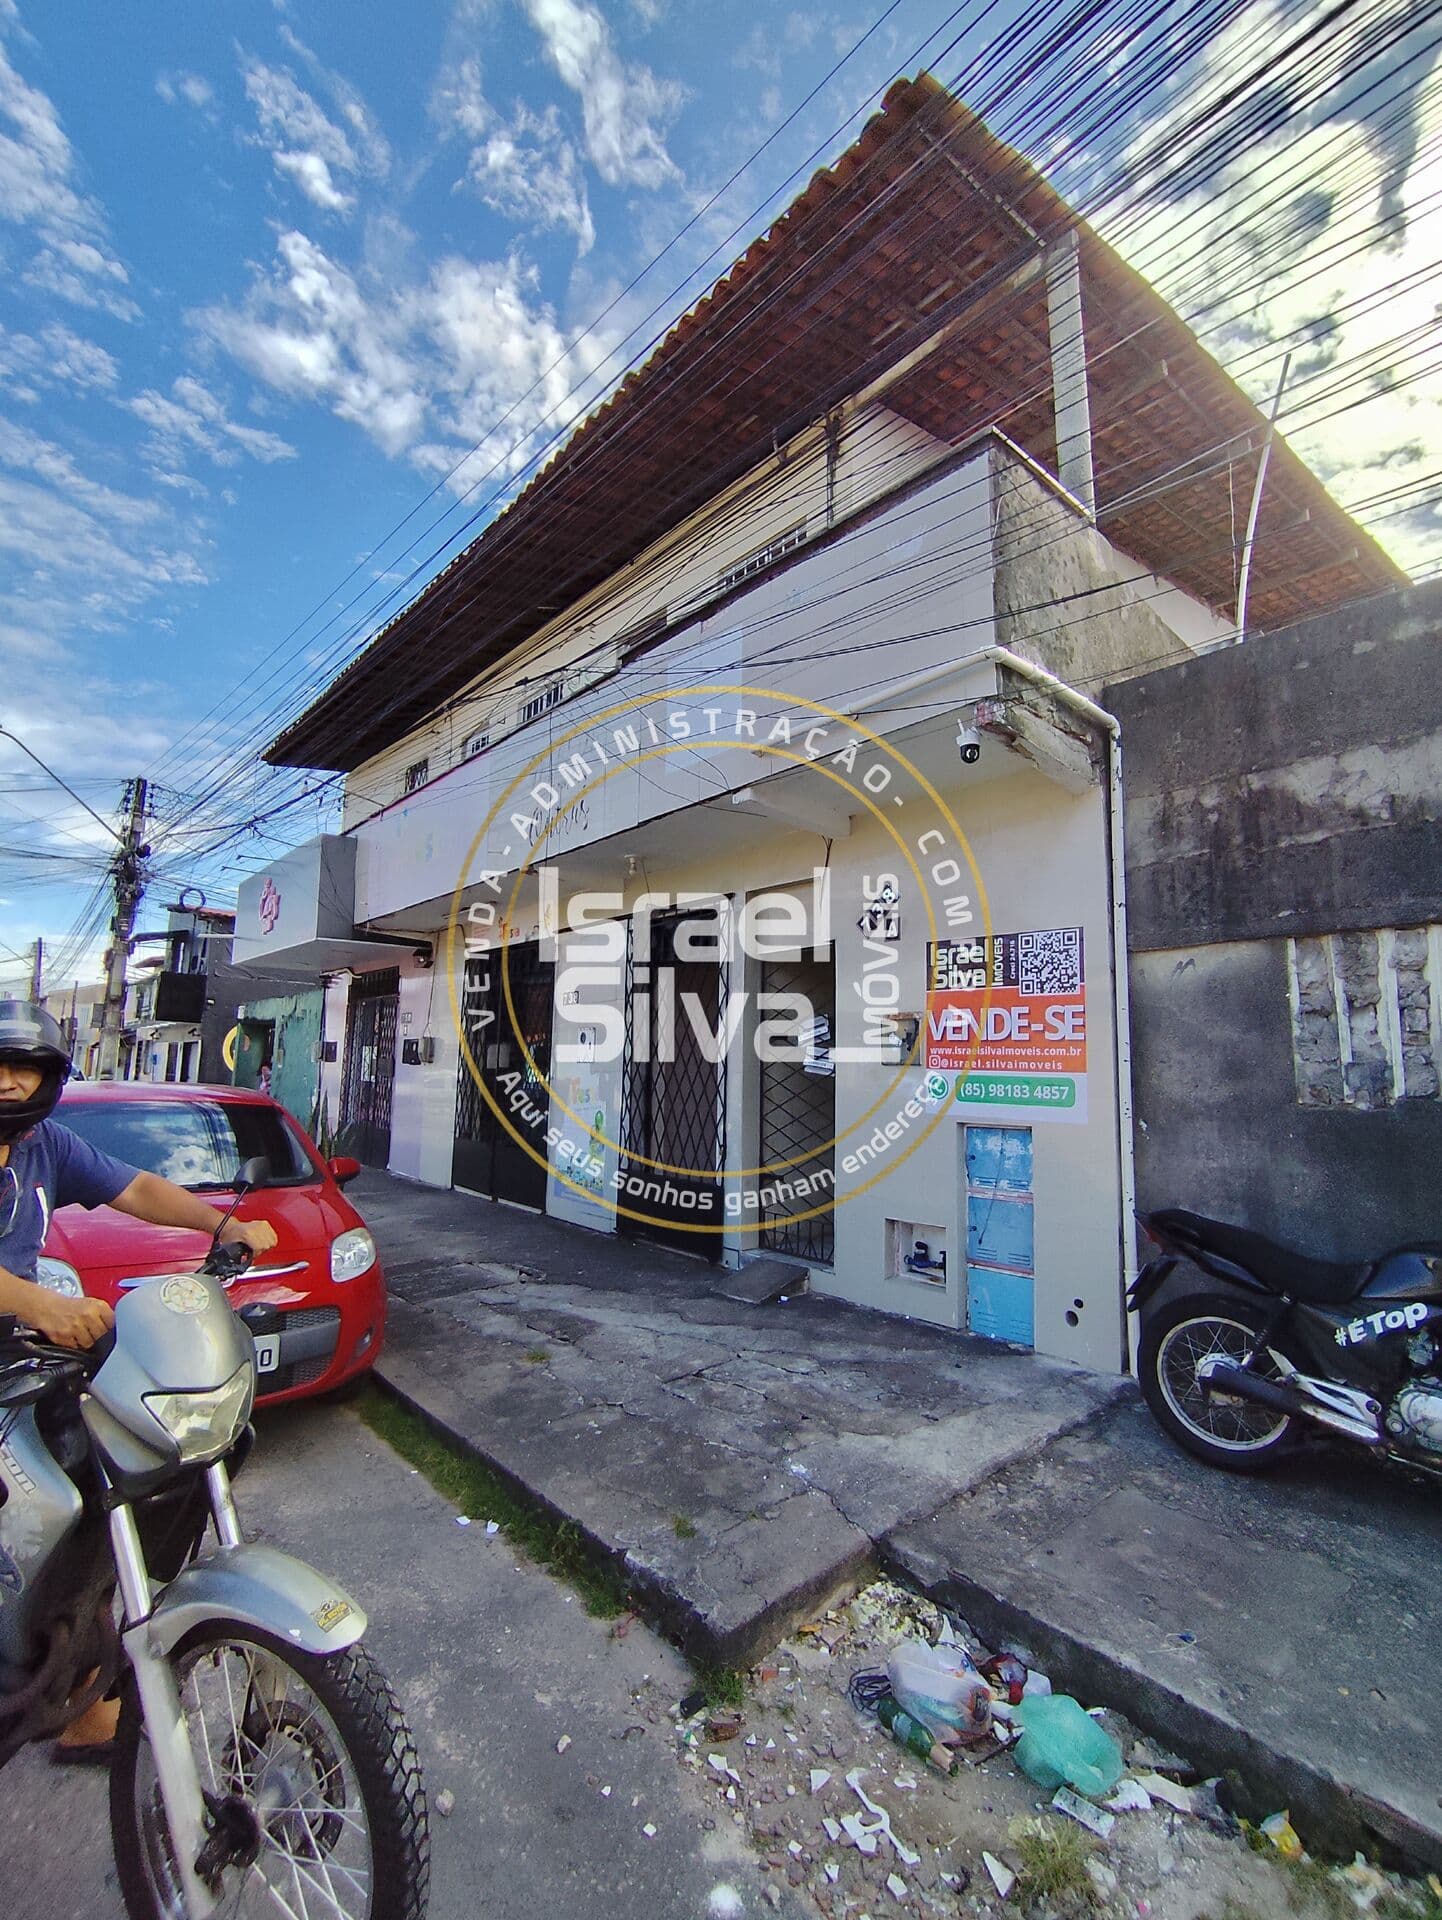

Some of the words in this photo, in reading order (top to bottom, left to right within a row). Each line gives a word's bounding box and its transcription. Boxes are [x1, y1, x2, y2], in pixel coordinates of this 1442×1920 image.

[930, 938, 990, 967] Israel
[933, 965, 987, 989] Silva
[926, 1004, 1085, 1041] VENDE-SE
[929, 1045, 1082, 1057] www.israelsilvaimoveis.com.br
[960, 1082, 985, 1098] (85)
[988, 1083, 1030, 1099] 98183
[1033, 1085, 1069, 1101] 4857
